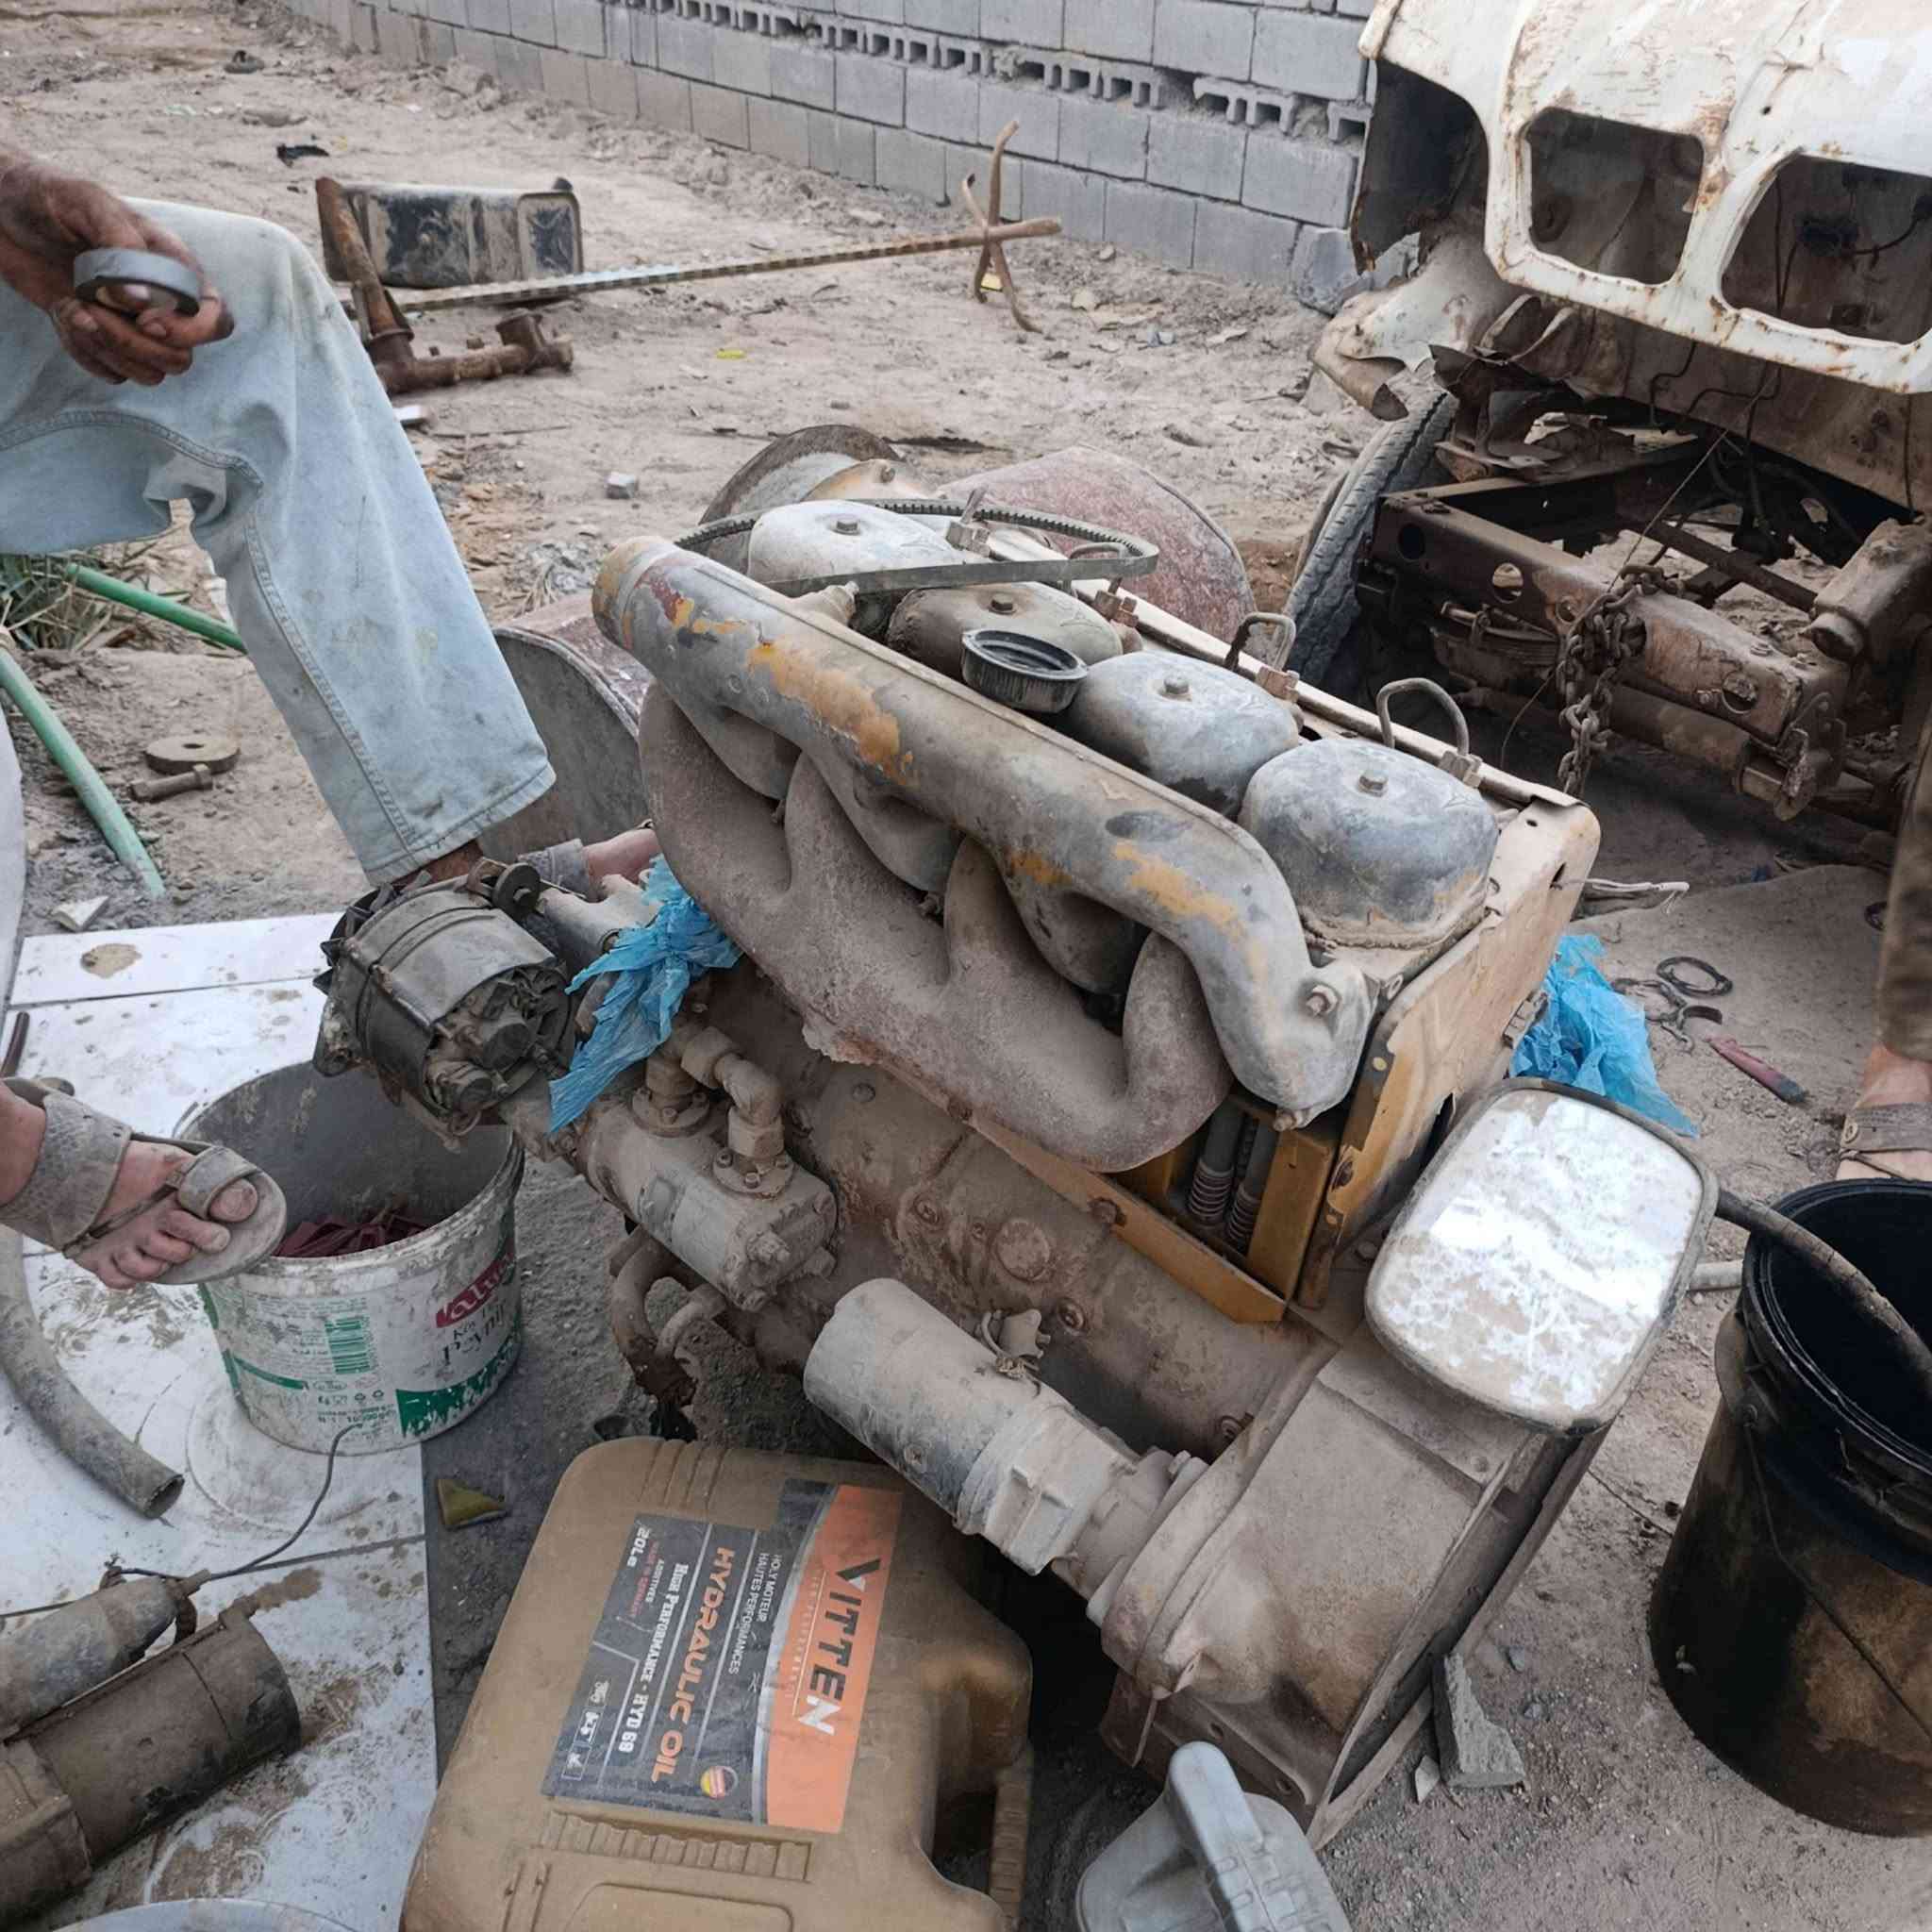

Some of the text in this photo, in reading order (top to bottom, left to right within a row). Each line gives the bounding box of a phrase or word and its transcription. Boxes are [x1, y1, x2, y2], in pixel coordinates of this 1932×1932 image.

[645, 1558, 664, 1603] ADDITIVES
[728, 1552, 769, 1674] HAUTES PERFORMANCES
[758, 1554, 781, 1623] HOLY MOTEUR
[651, 1546, 735, 1783] HYDRAULIC OIL
[798, 1558, 881, 1736] VITTEN
[626, 1693, 650, 1729] HYD
